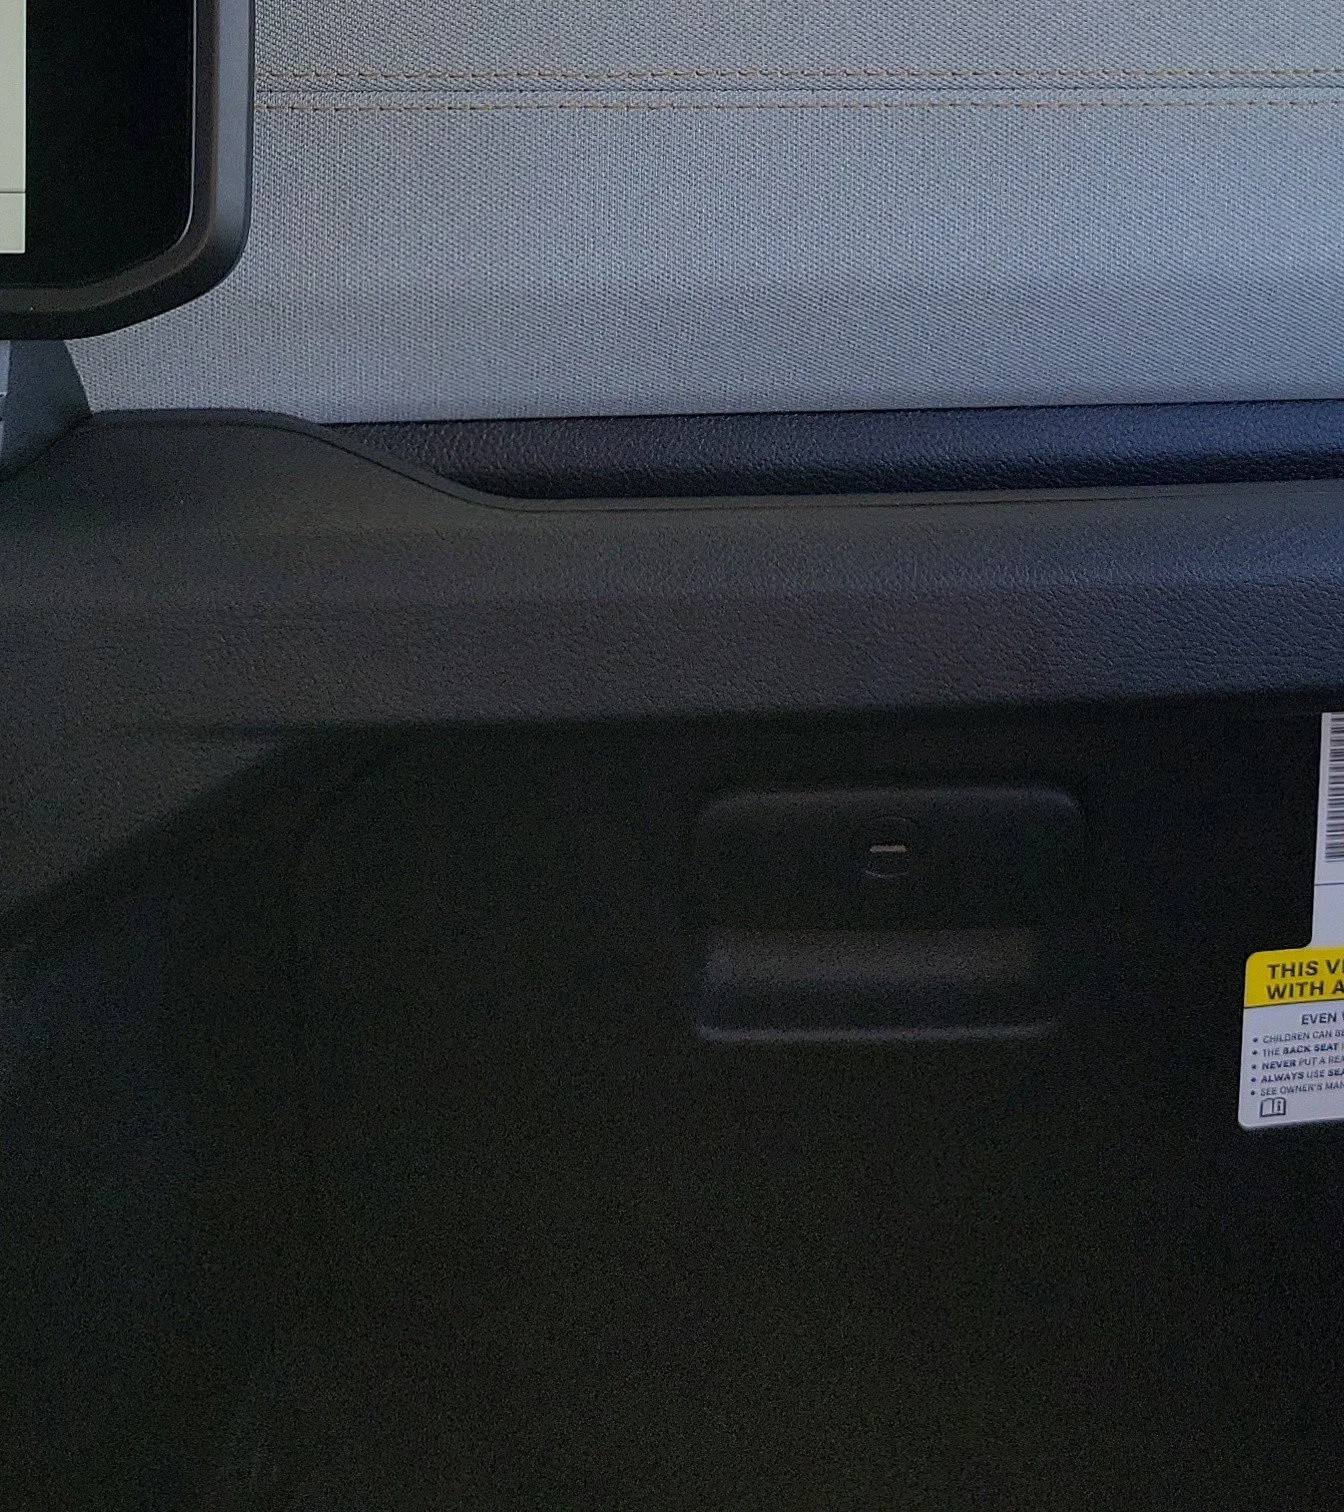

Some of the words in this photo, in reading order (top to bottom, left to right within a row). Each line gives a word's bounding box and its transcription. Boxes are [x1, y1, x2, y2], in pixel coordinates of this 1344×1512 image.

[1267, 960, 1319, 979] THIS
[1266, 980, 1324, 1000] WITH
[1301, 1012, 1337, 1025] EVEN
[1312, 1030, 1332, 1039] CAN
[1262, 1048, 1280, 1058] THE
[1282, 1045, 1311, 1055] BACK
[1313, 1042, 1339, 1053] SEAT
